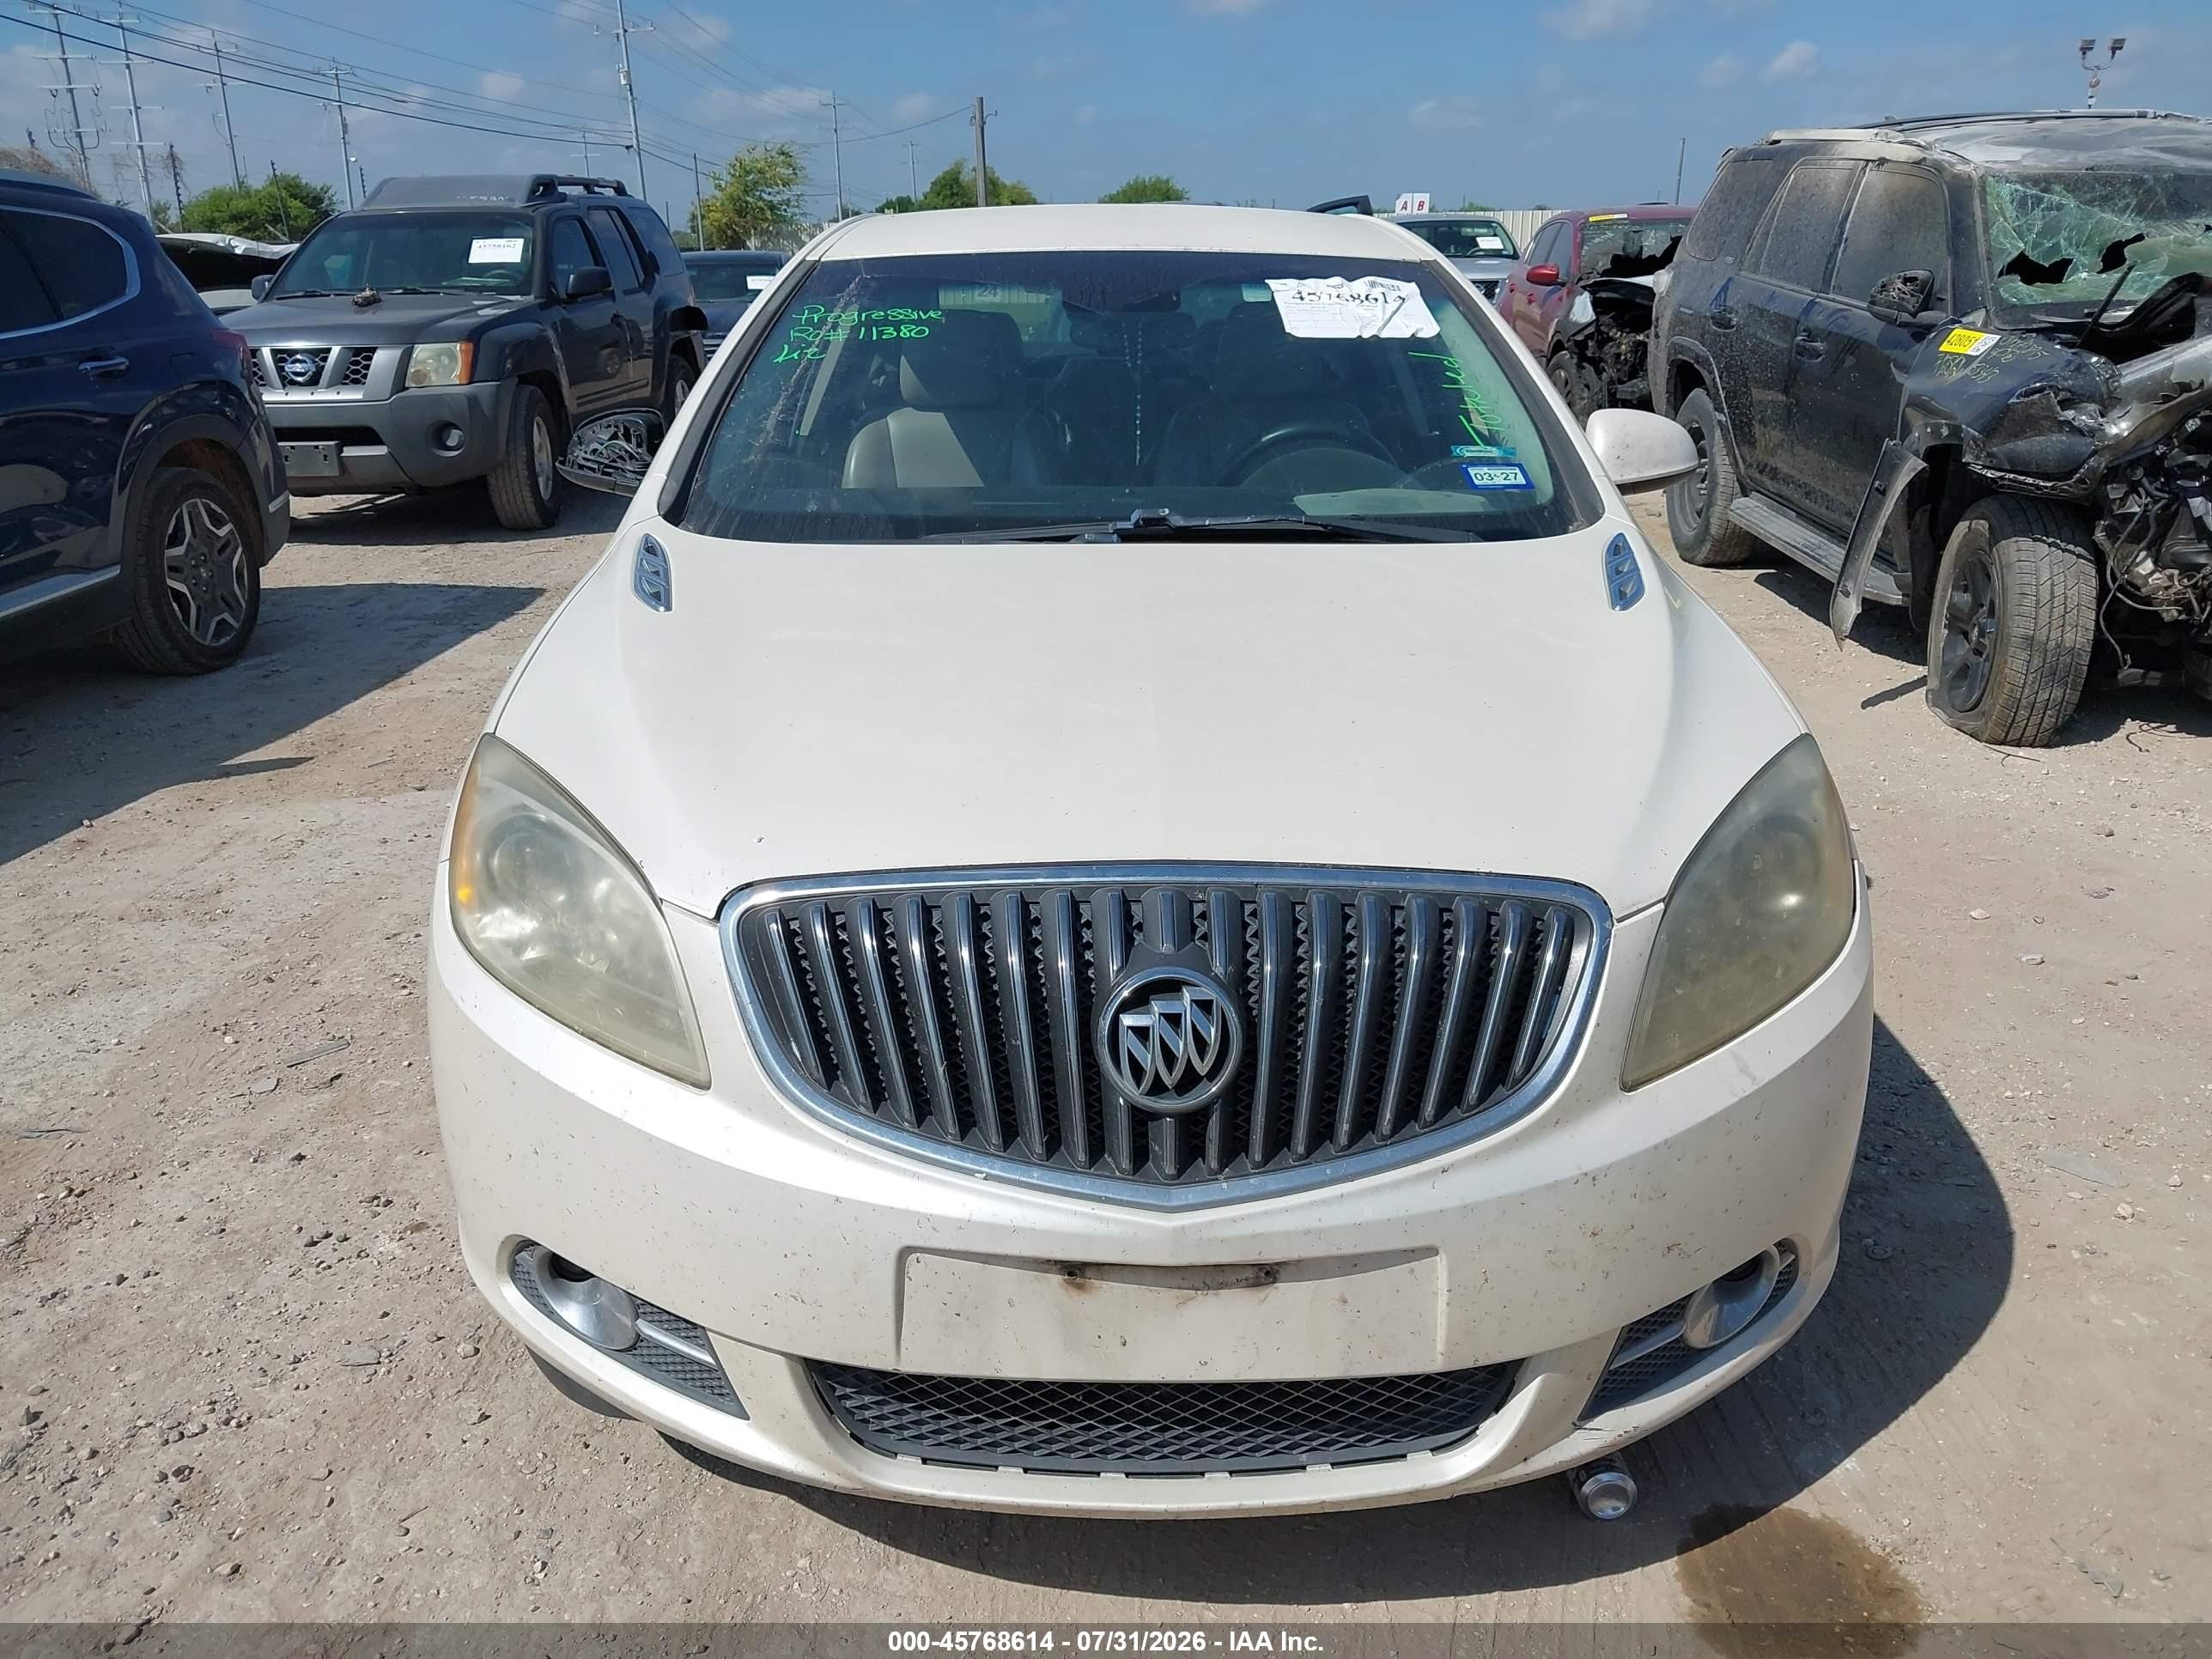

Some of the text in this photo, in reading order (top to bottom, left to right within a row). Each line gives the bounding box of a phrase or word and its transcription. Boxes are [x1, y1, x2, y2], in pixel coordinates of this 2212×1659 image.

[1401, 200, 1408, 211] A
[1417, 200, 1425, 211] B
[792, 305, 944, 325] Progressive
[859, 325, 930, 341] 11380
[1474, 472, 1518, 482] 03 27
